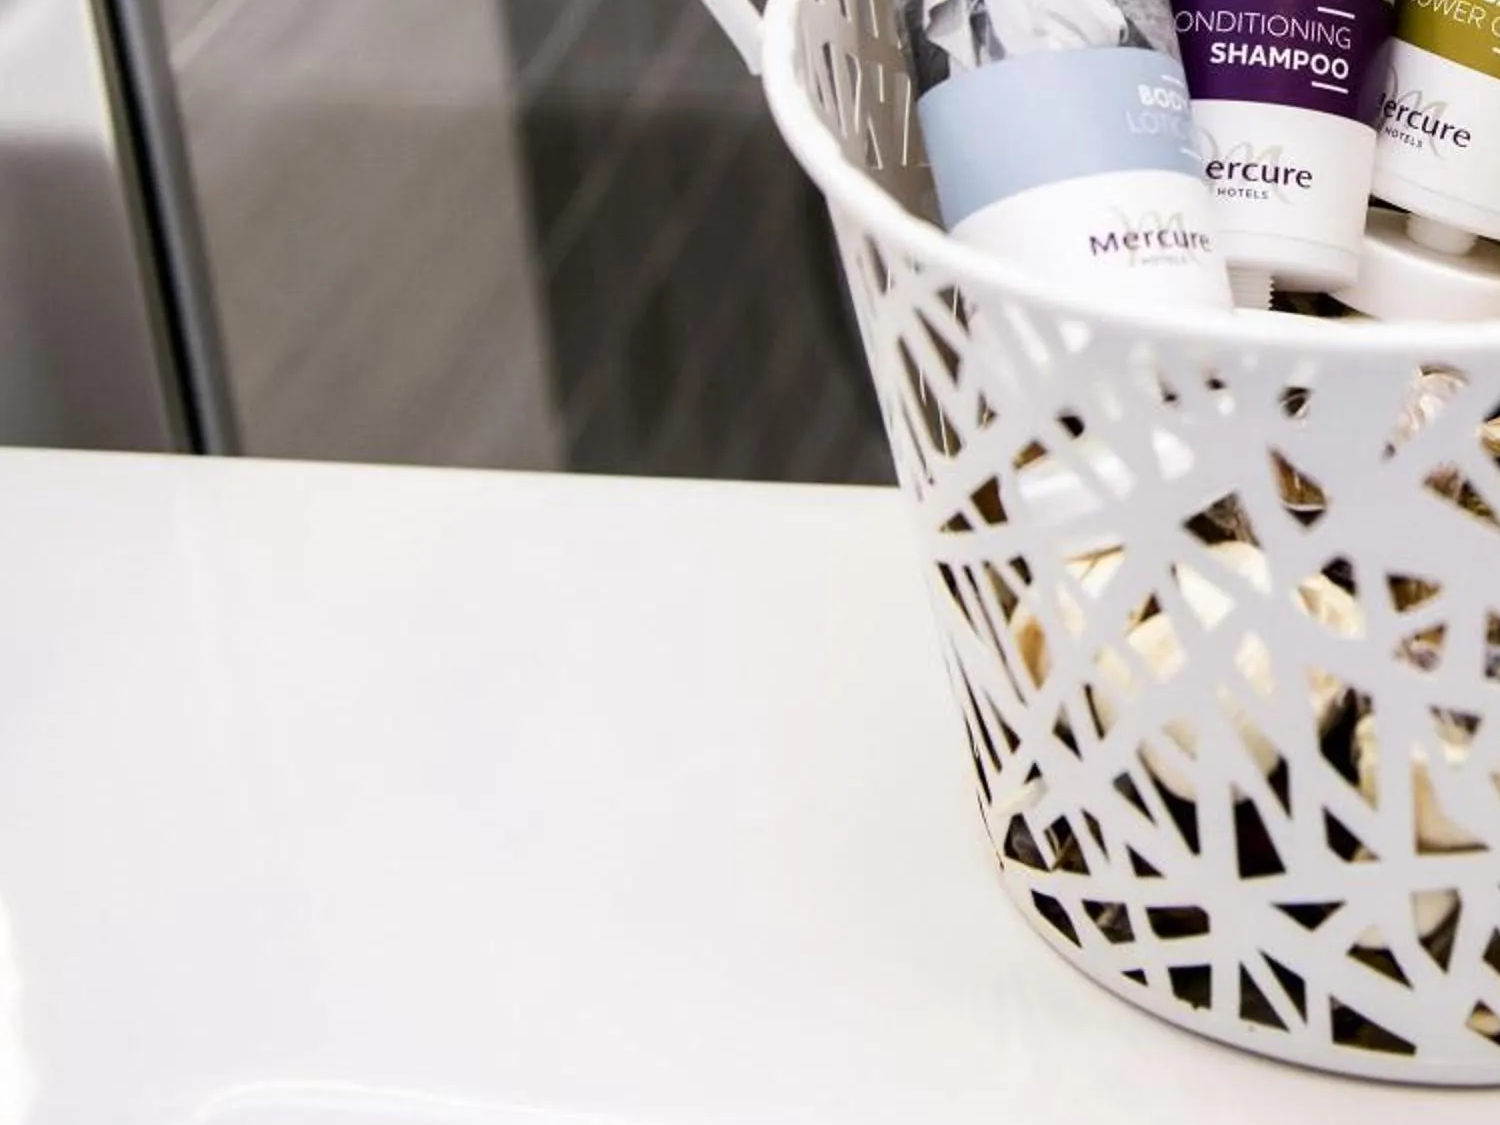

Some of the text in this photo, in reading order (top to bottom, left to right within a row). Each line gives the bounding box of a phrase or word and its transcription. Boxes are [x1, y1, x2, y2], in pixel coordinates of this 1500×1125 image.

[1174, 10, 1352, 50] ONDITIONING
[1210, 41, 1350, 80] SHAMPOO
[1204, 159, 1313, 189] ercure
[1216, 187, 1270, 200] HOTELS
[1089, 228, 1213, 256] Mercure
